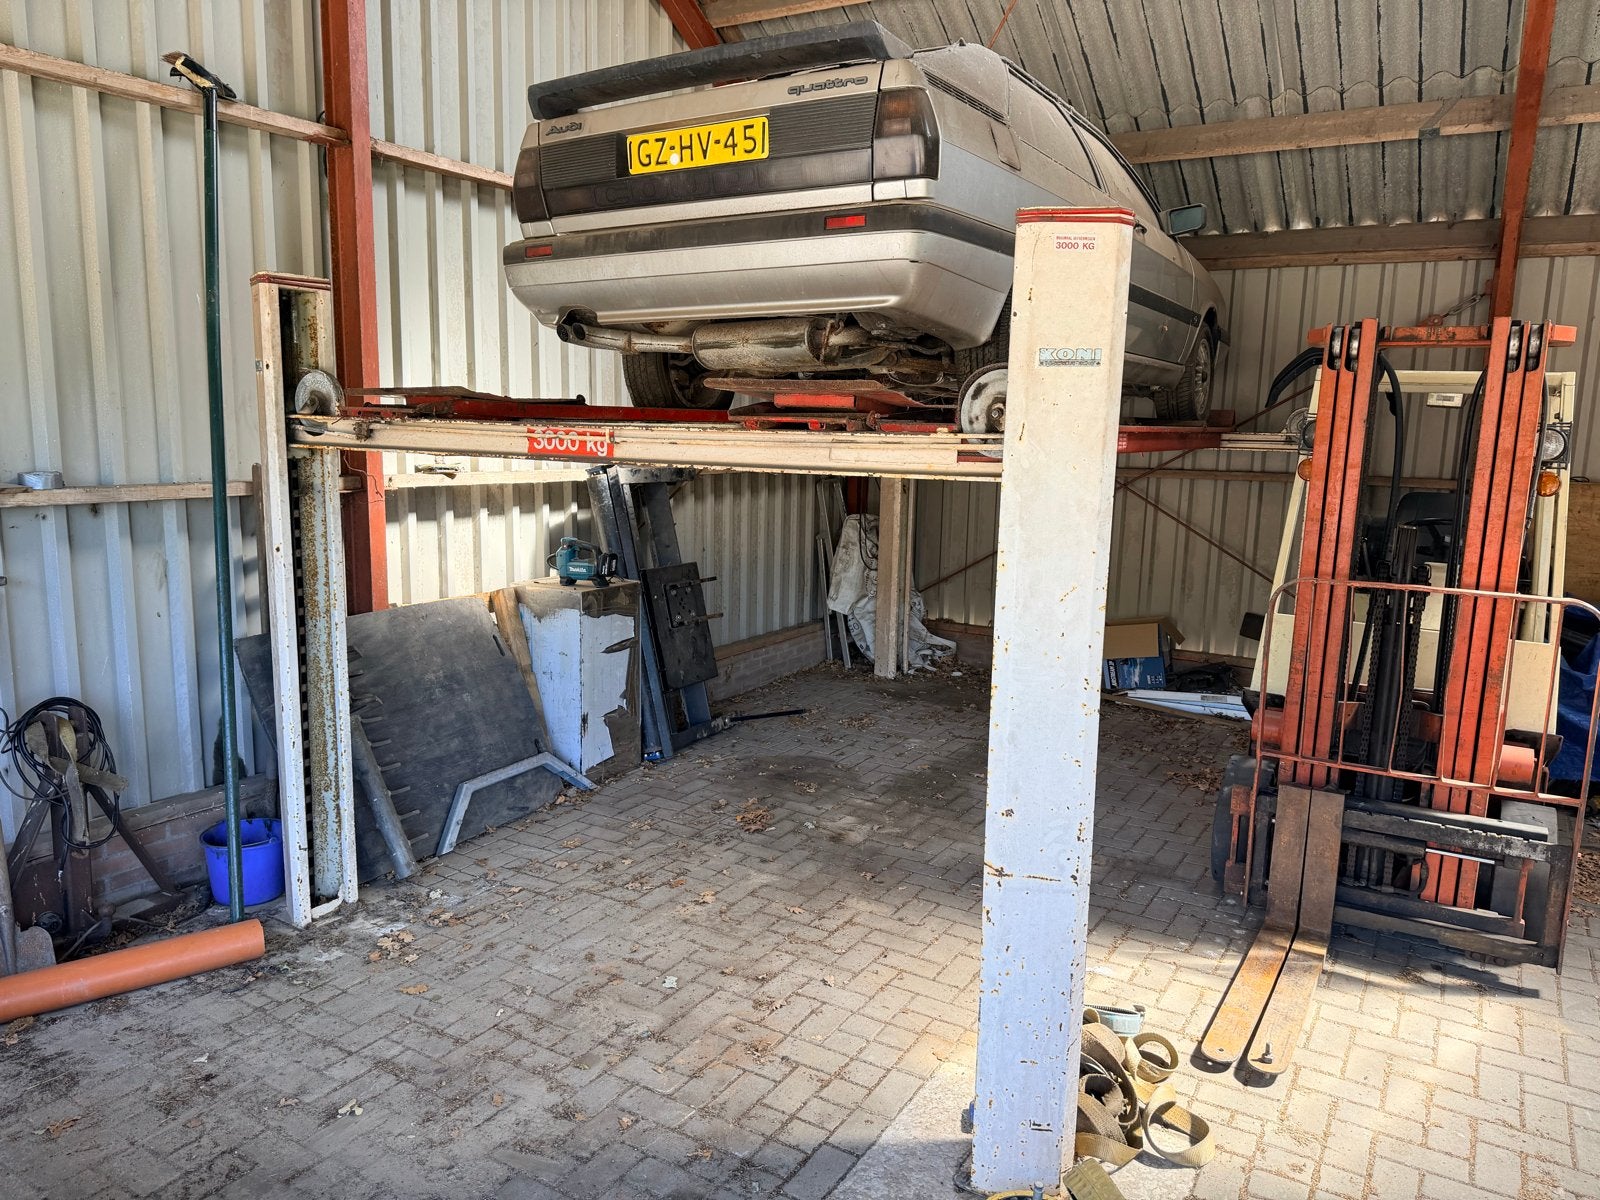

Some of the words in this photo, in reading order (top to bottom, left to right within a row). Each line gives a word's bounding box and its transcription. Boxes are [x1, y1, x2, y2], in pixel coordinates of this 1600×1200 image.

[788, 76, 868, 96] quattro
[545, 122, 582, 136] Audi
[637, 124, 757, 167] GZ-HV-45
[1056, 241, 1079, 250] 3000
[1082, 242, 1095, 250] KG
[1039, 348, 1102, 361] KONI
[533, 428, 579, 451] 3000
[586, 431, 608, 457] kg
